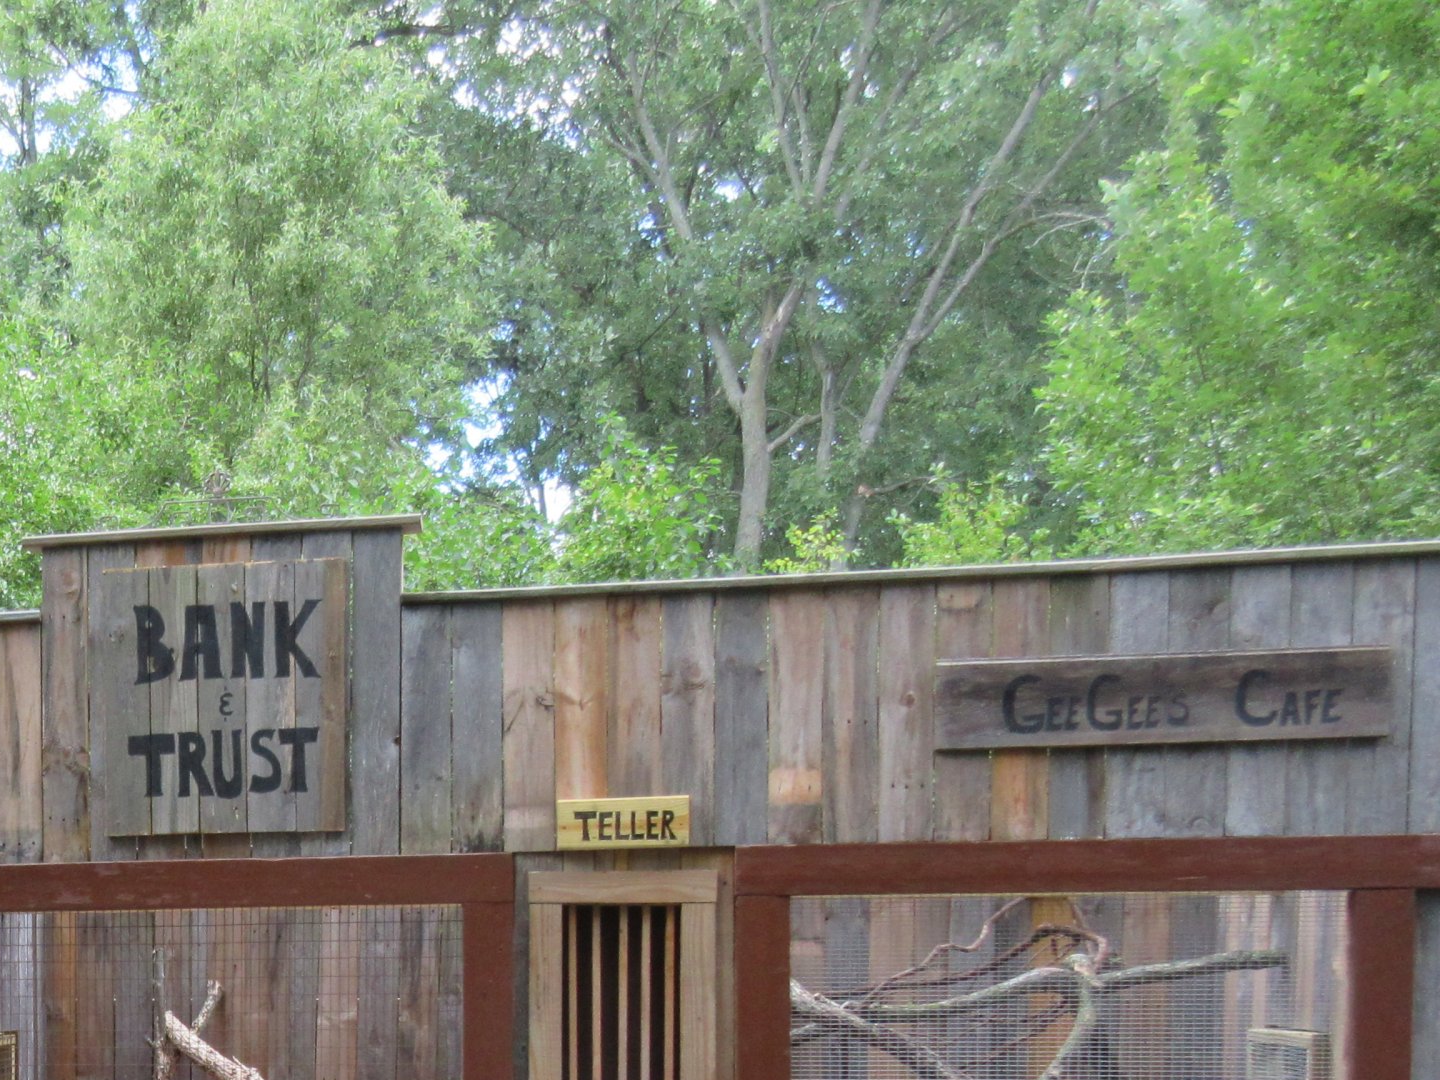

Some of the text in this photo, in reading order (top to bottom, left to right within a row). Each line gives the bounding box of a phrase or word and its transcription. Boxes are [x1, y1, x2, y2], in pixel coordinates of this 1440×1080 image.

[133, 599, 323, 685] BANK
[218, 687, 234, 722] &
[127, 726, 320, 800] TRUST
[573, 810, 677, 841] TELLER
